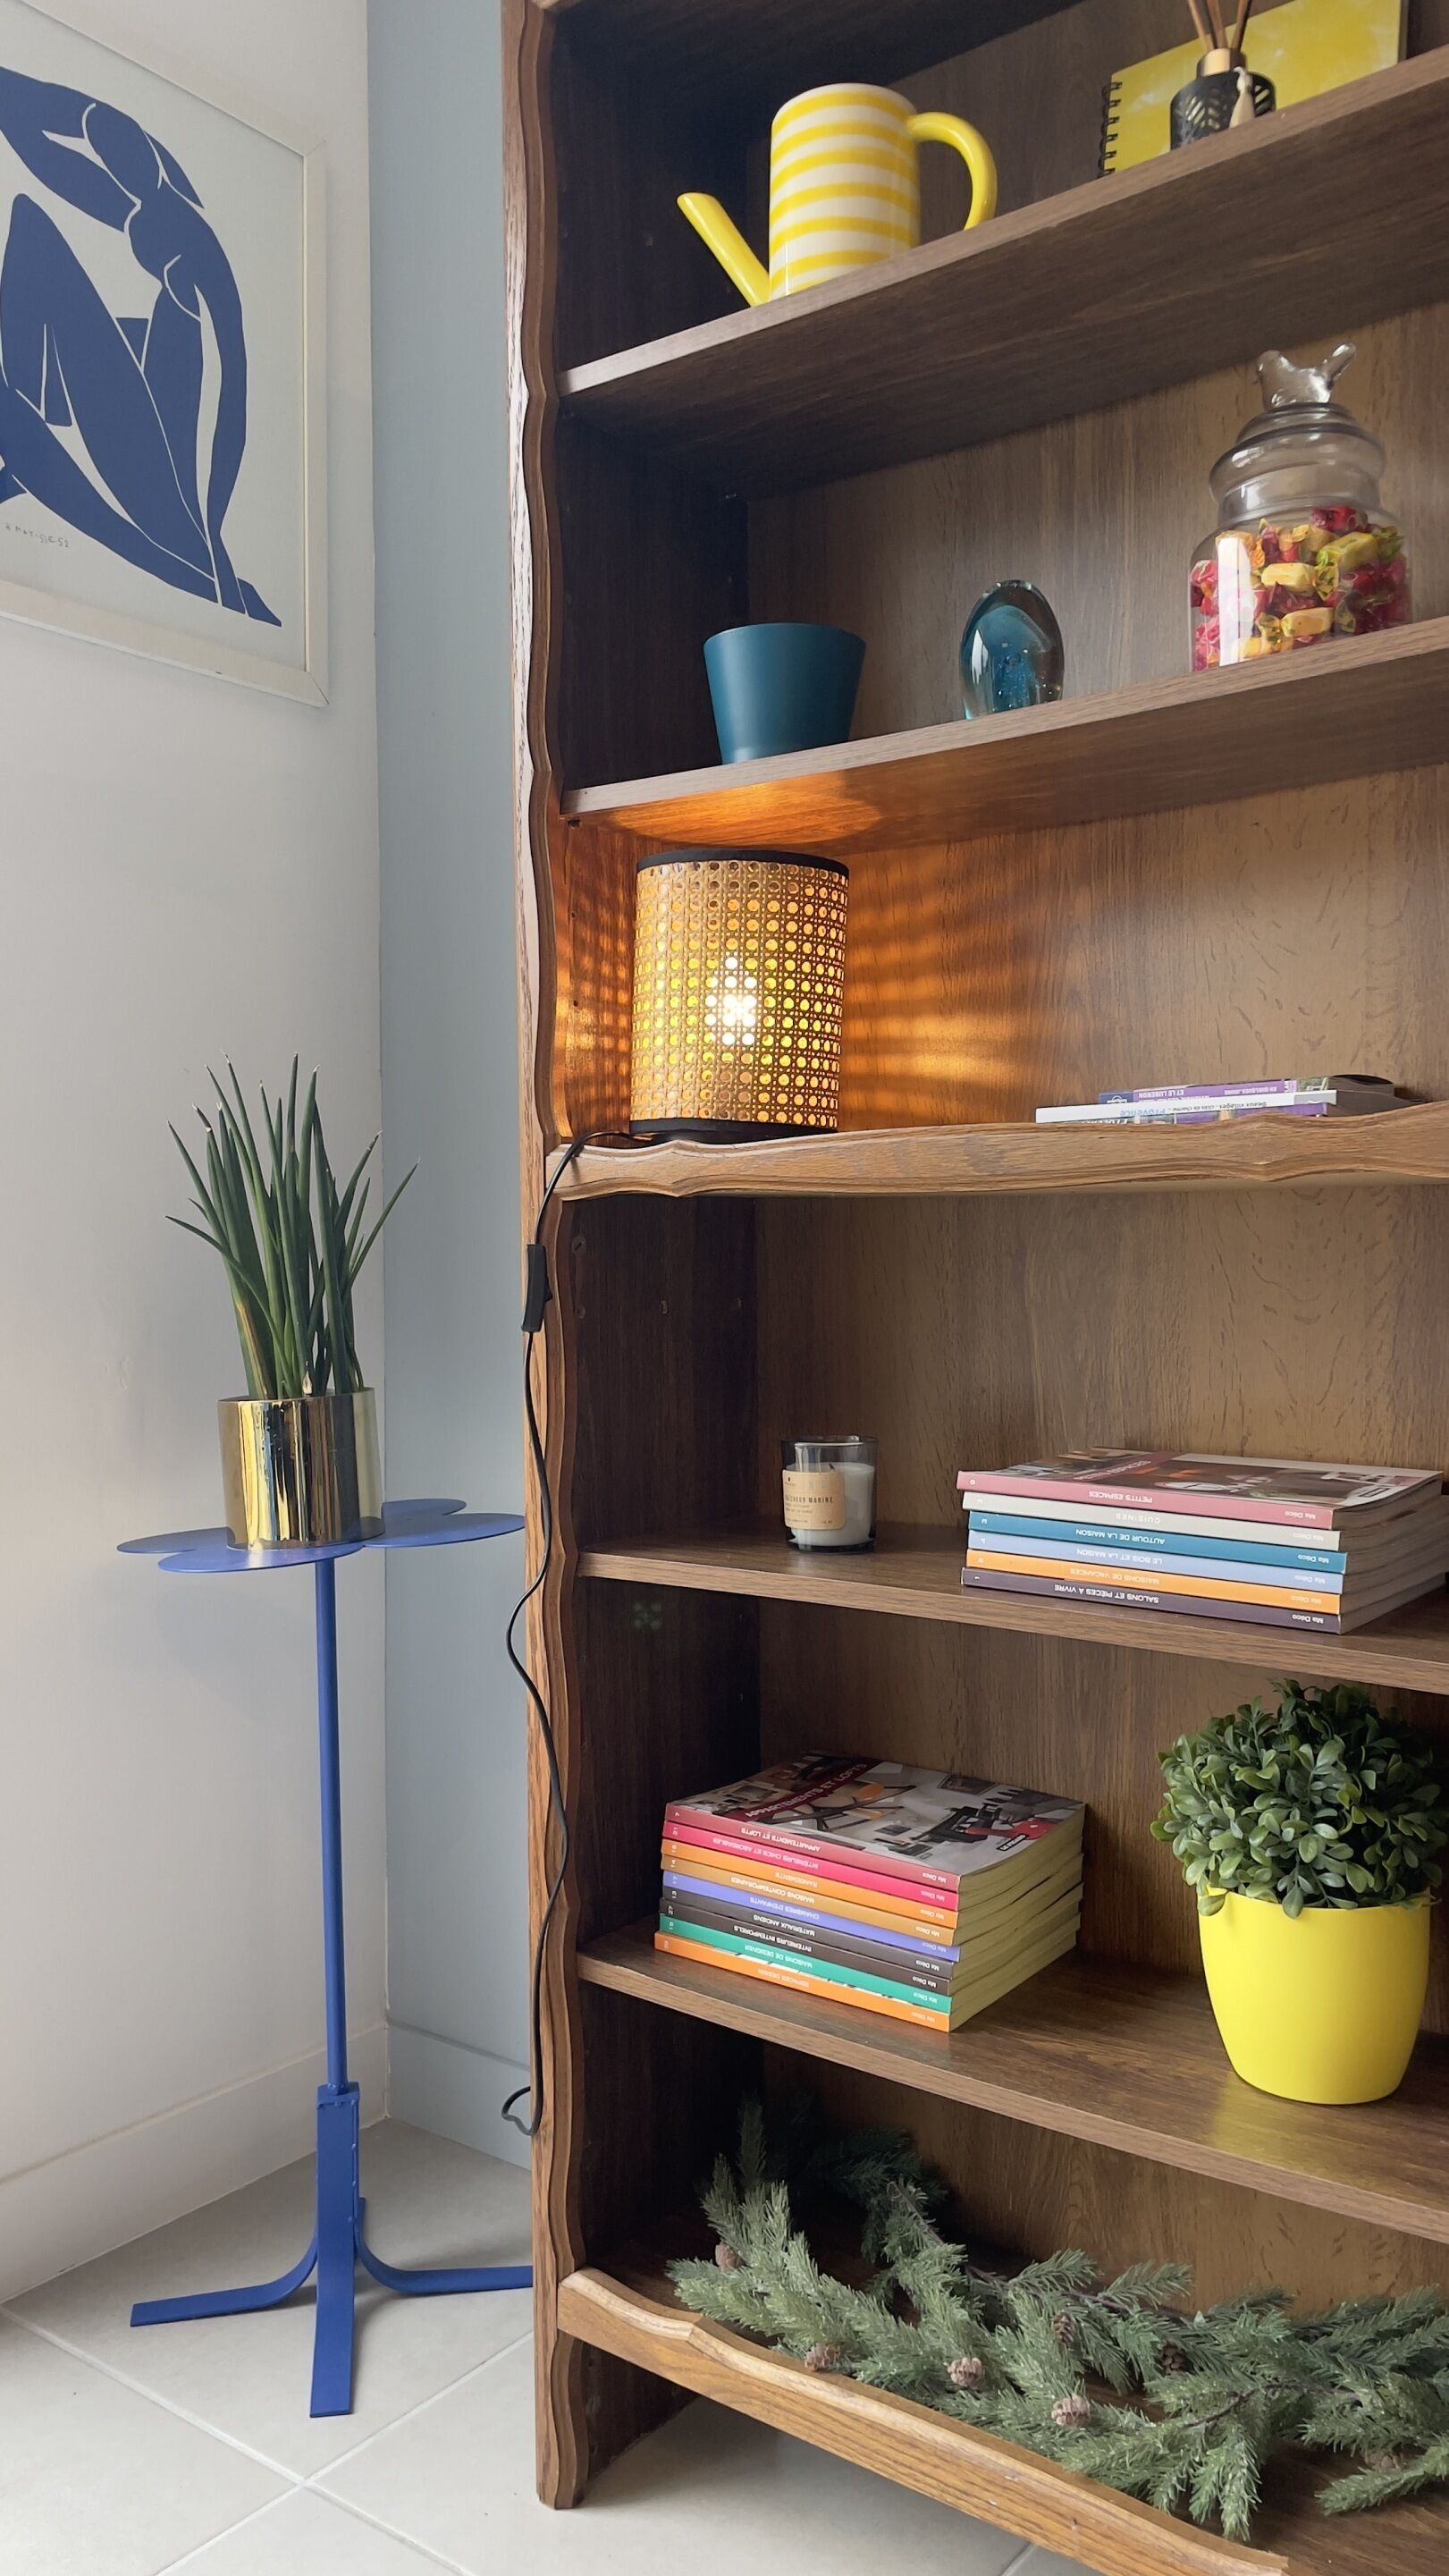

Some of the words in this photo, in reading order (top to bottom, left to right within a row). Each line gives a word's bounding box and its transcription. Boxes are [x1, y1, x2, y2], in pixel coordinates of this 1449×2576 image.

[1120, 1108, 1166, 1117] Provence
[1089, 1491, 1124, 1500] ESPACES
[1125, 1494, 1152, 1503] PETITS
[1116, 1513, 1160, 1524] CUISINES
[1076, 1529, 1105, 1538] MAISON
[1132, 1535, 1165, 1545] AUTOUR
[1077, 1549, 1106, 1558] MAISON
[1133, 1555, 1150, 1563] BOIS
[1070, 1567, 1109, 1578] VACANCES
[1125, 1575, 1159, 1584] MAISONS
[1055, 1584, 1076, 1593] VIVRE
[1086, 1588, 1113, 1598] PIÈCES
[1127, 1593, 1159, 1604] SALONS
[741, 1828, 761, 1839] LOFTS
[762, 1833, 771, 1843] ET
[712, 1837, 753, 1855] ABORDABLES
[771, 1834, 821, 1852] APPARTEMENTS
[753, 1848, 762, 1857] ET
[762, 1849, 781, 1862] CHICS
[775, 1872, 818, 1888] RANGEMENTS
[730, 1877, 786, 1897] CONTEMPORAINES
[787, 1891, 814, 1905] MAISONS
[750, 1896, 783, 1912] D'ENFANTS
[784, 1905, 820, 1921] CHAMBRES
[753, 1914, 779, 1927] ANCIENS
[733, 1925, 775, 1943] INTEMPORELS
[745, 1945, 774, 1960] DESIGNER
[775, 1953, 783, 1961] DE
[784, 1955, 813, 1969] MAISONS
[931, 1964, 939, 1972] Ma
[781, 1974, 809, 1988] ESPACES
[927, 1981, 936, 1989] Ma
